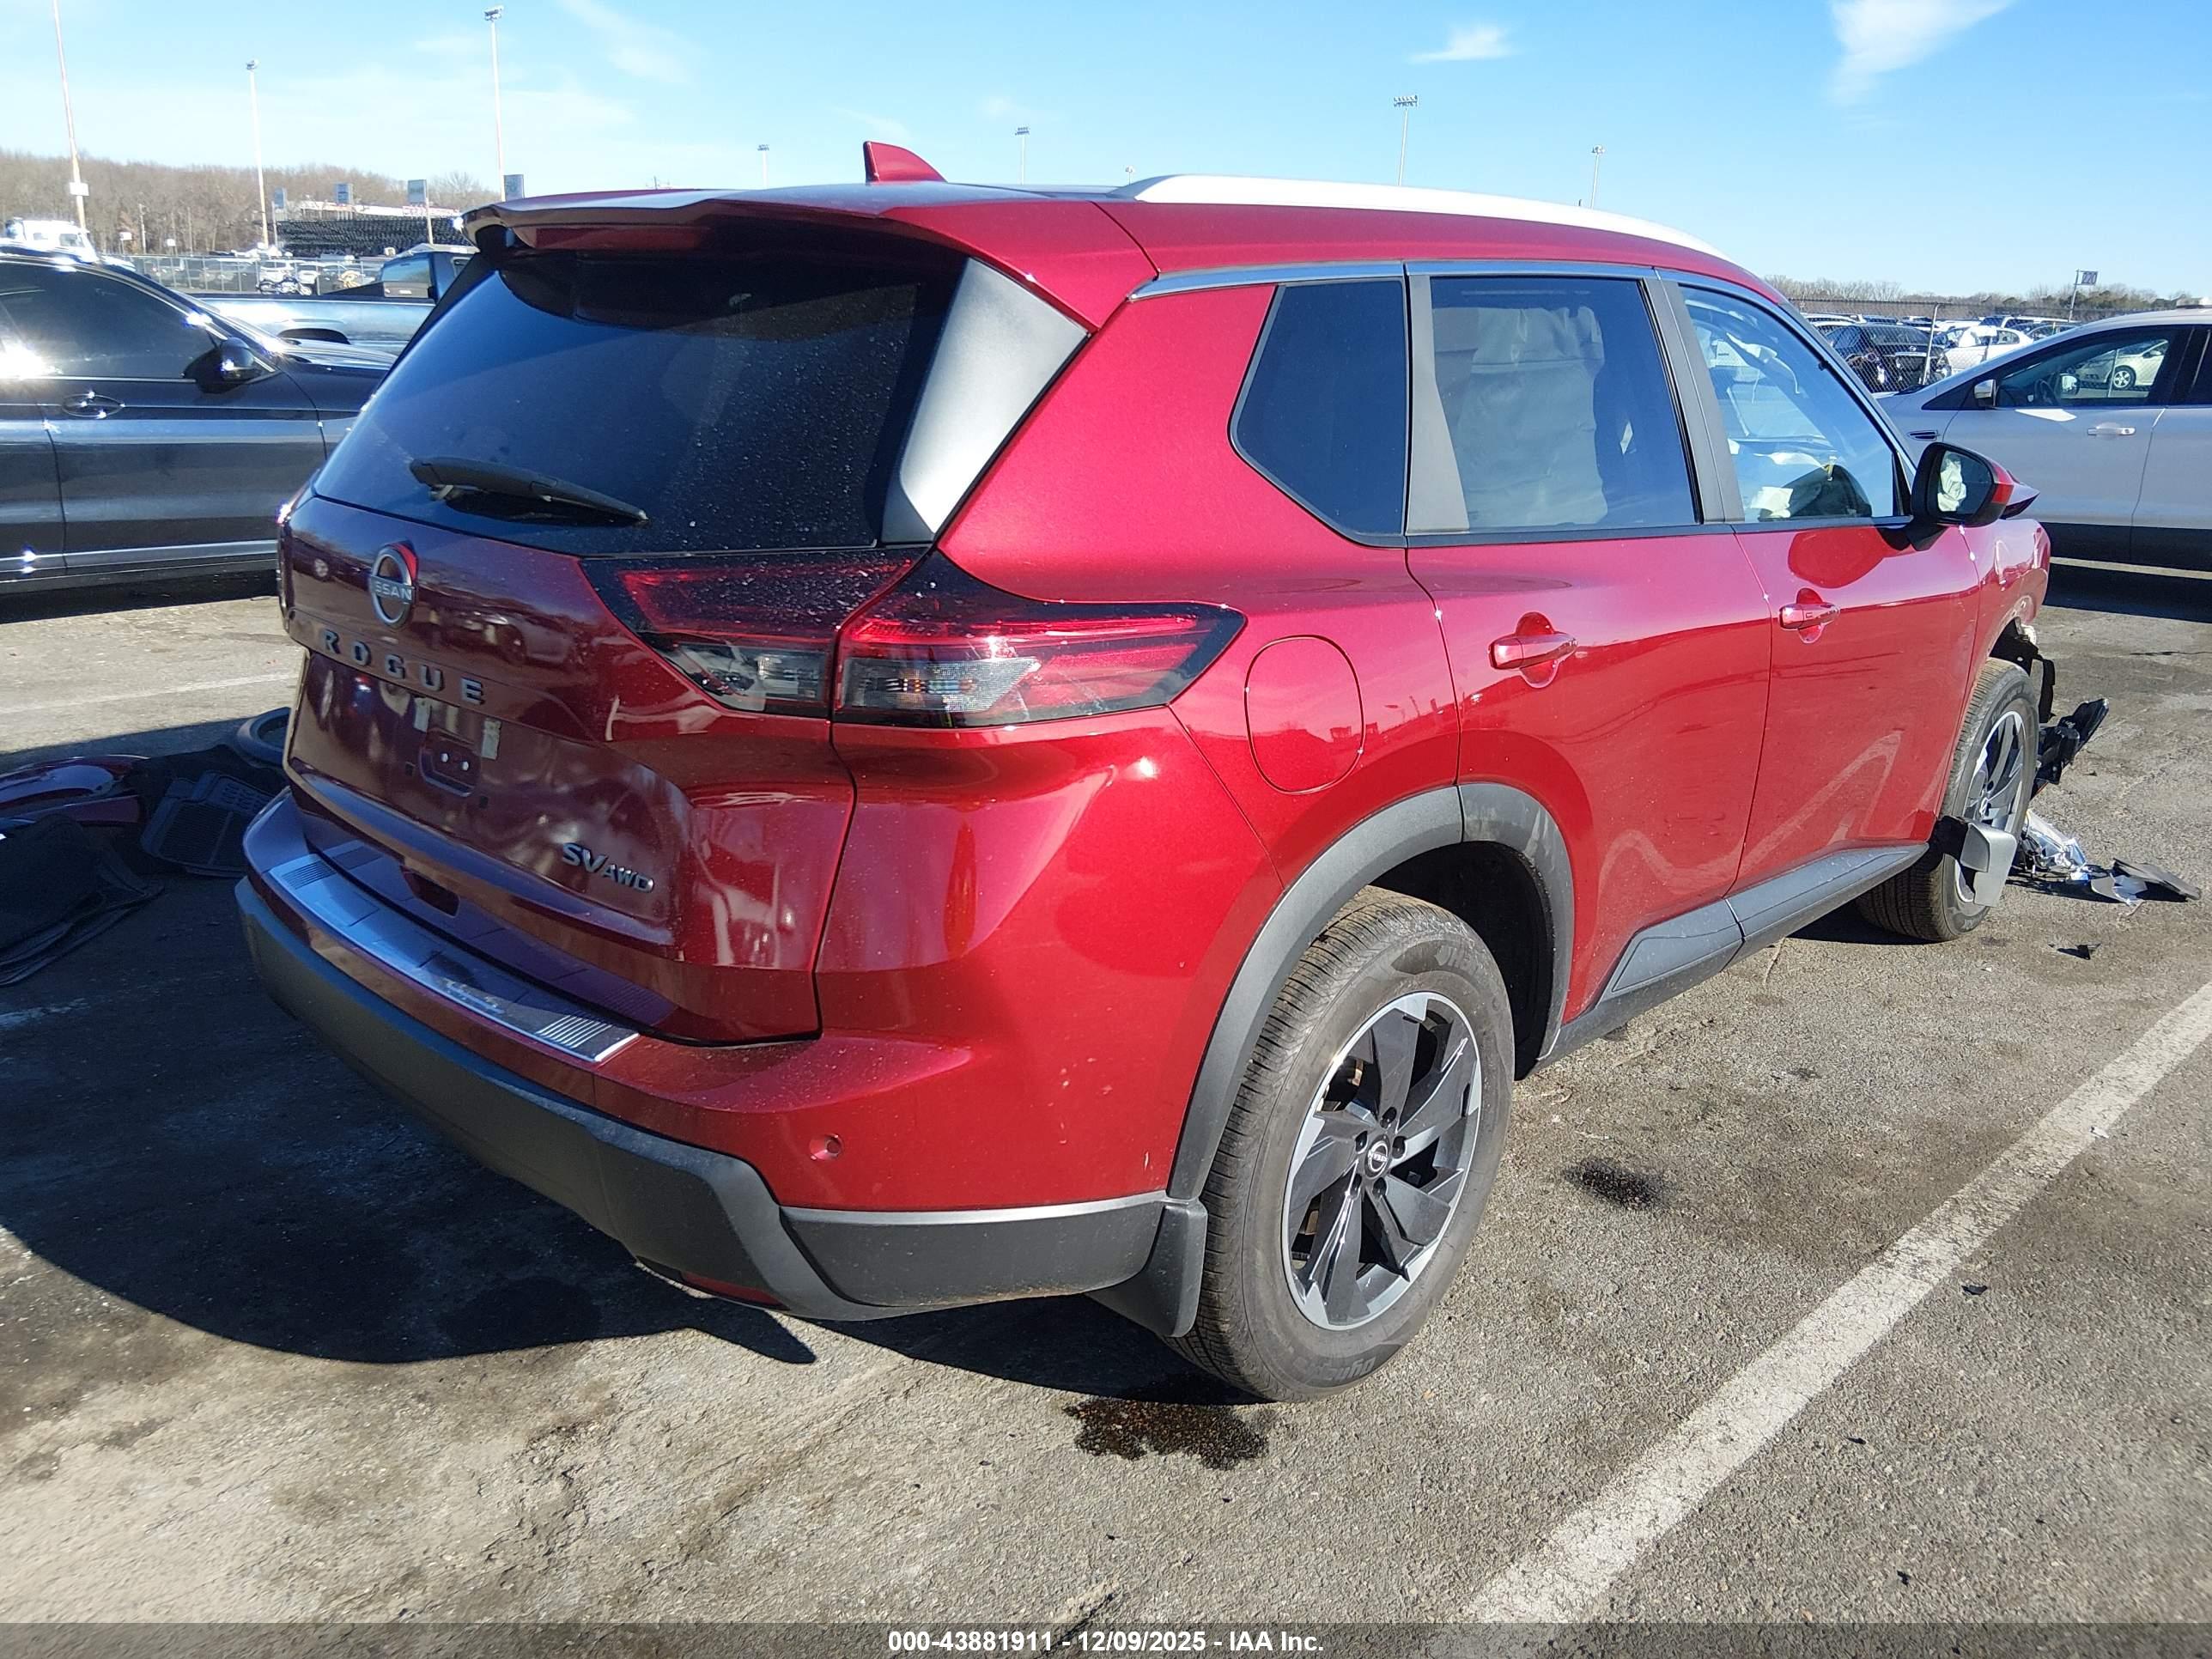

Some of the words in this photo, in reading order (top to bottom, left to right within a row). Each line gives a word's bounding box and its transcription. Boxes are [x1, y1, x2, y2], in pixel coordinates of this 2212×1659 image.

[374, 580, 412, 601] SSAN
[322, 629, 484, 705] ROGUE
[562, 842, 608, 873] SV
[602, 864, 654, 892] AWD
